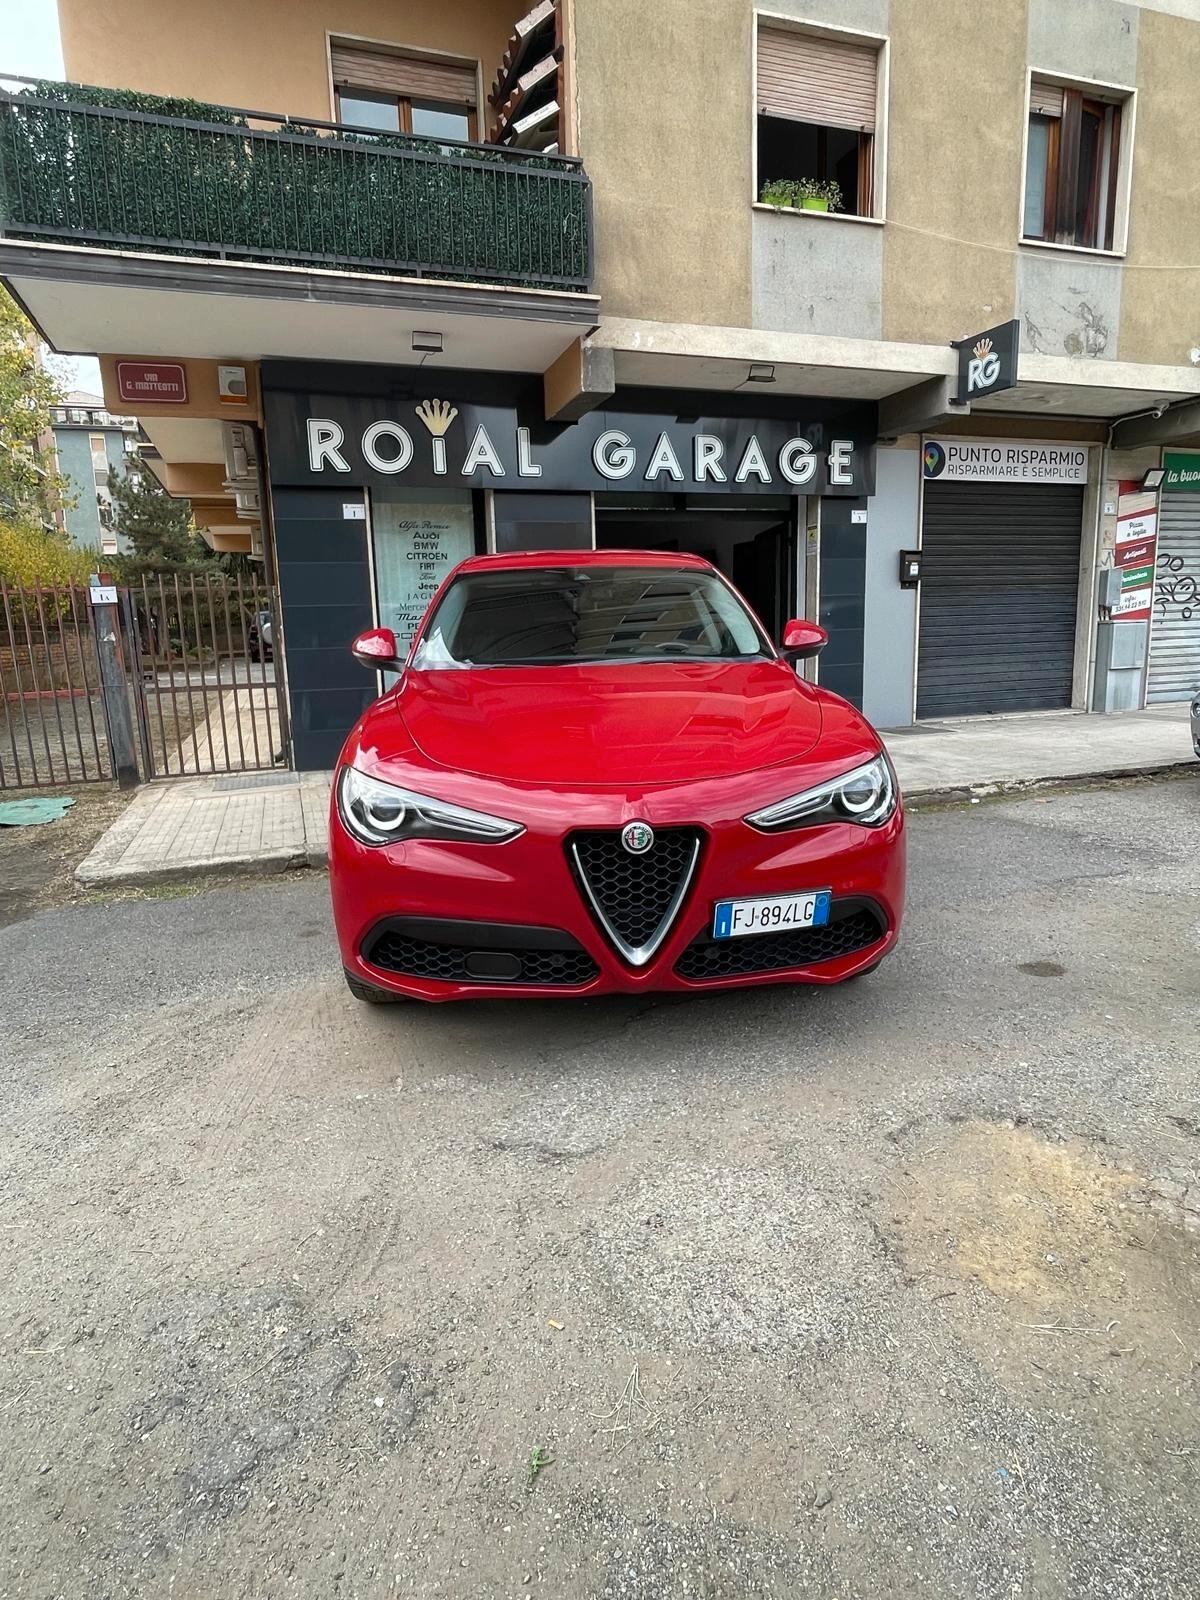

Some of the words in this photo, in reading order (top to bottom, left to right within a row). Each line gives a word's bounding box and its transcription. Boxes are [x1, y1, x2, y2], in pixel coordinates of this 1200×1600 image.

[143, 373, 158, 382] VIA
[968, 352, 1001, 392] RG
[135, 382, 179, 392] MATTEOTTI
[592, 429, 854, 486] GARAGE
[948, 447, 1001, 463] PUNTO
[1007, 449, 1085, 466] RISPARMIO
[948, 464, 1019, 477] RISPARMIARE
[1031, 466, 1080, 479] SEMPLICE
[1167, 470, 1179, 483] la
[413, 541, 439, 550] BMW
[419, 562, 435, 571] FIAT
[418, 582, 439, 591] Jeep
